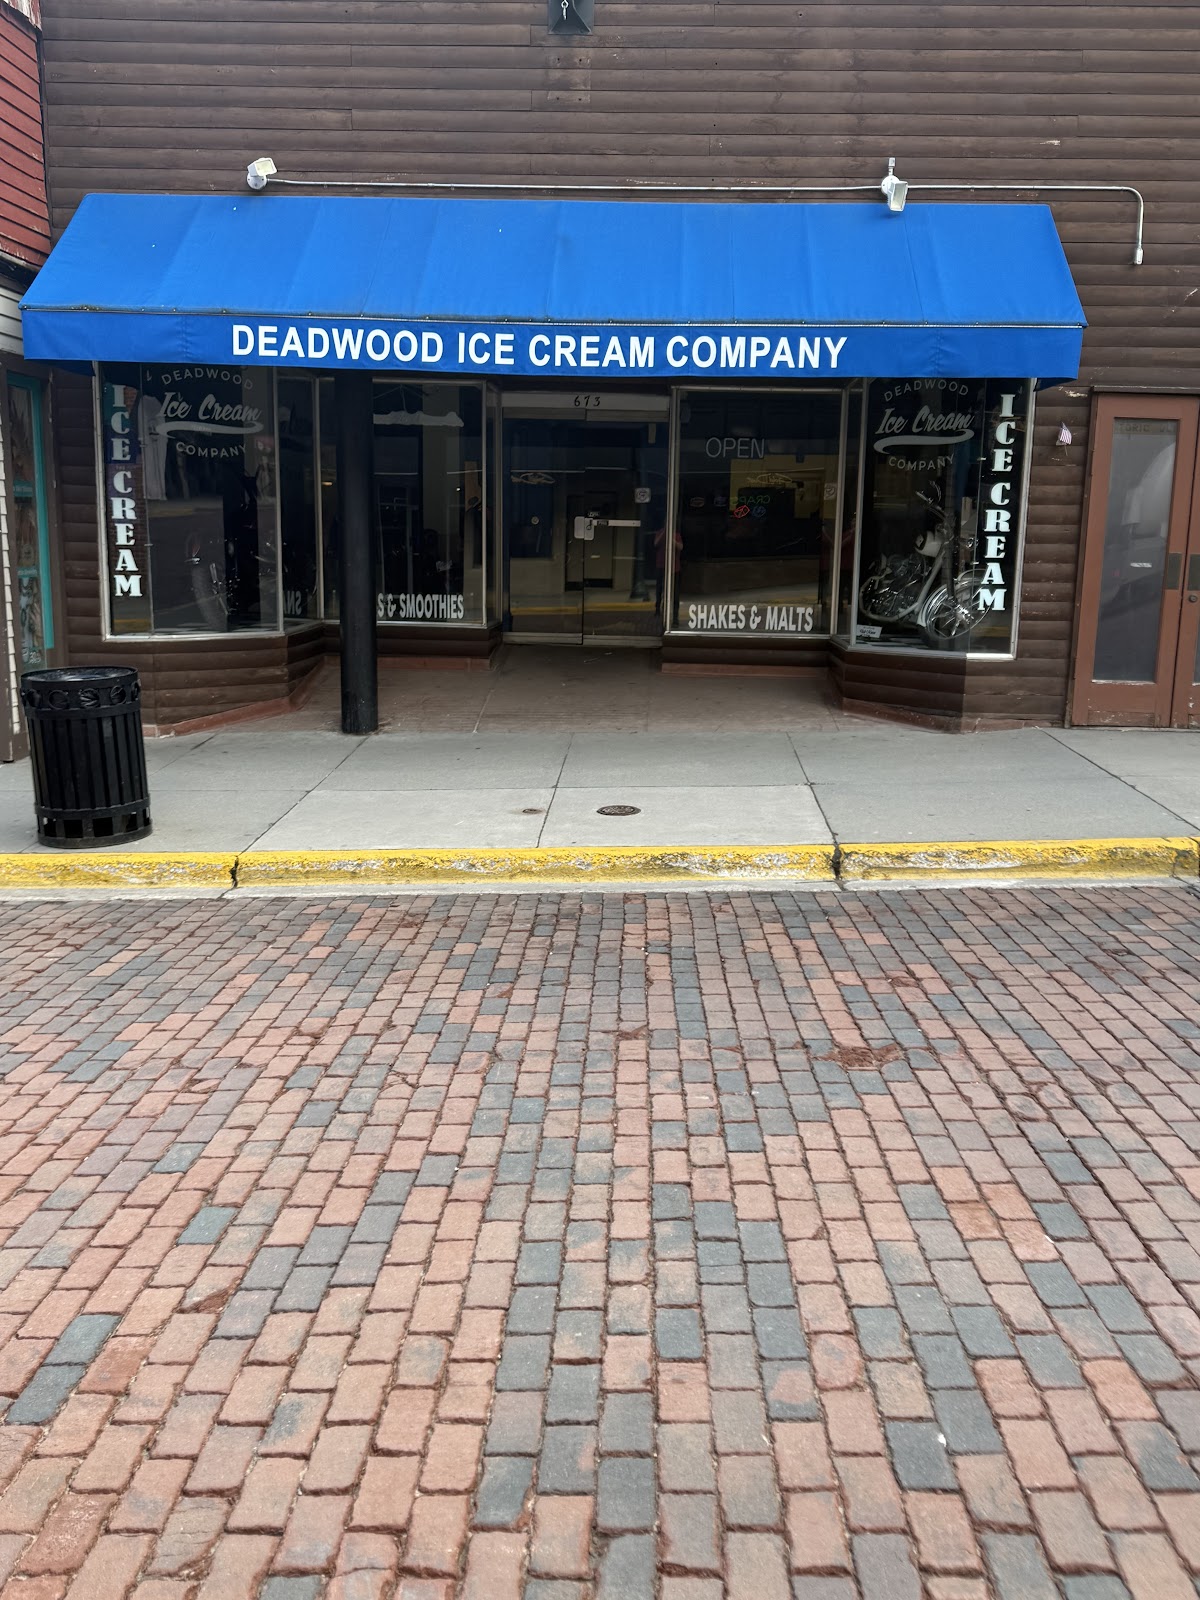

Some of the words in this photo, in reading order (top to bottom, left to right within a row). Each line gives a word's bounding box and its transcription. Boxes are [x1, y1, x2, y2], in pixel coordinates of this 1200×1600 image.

[232, 324, 443, 363] DEADWOOD
[458, 332, 515, 365] ICE
[529, 334, 655, 368] CREAM
[666, 335, 847, 369] COMPANY
[161, 367, 253, 390] DEADWOOD
[883, 379, 969, 402] DEADWOOD
[157, 392, 192, 419] Ice
[198, 393, 262, 422] Cream
[574, 395, 600, 407] 673
[110, 384, 131, 461] ICE
[875, 407, 908, 435] Ice
[912, 405, 975, 433] Cream
[991, 394, 1016, 472] ICE
[176, 441, 246, 458] COMPANY
[705, 437, 765, 459] OPEN
[889, 453, 955, 471] COMPANY
[110, 470, 143, 597] CREAM
[977, 482, 1012, 611] CREAM
[387, 593, 396, 618] &
[400, 593, 465, 620] SMOOTHIES
[688, 604, 746, 629] SHAKES
[750, 605, 761, 630] &
[765, 606, 814, 632] MALTS
